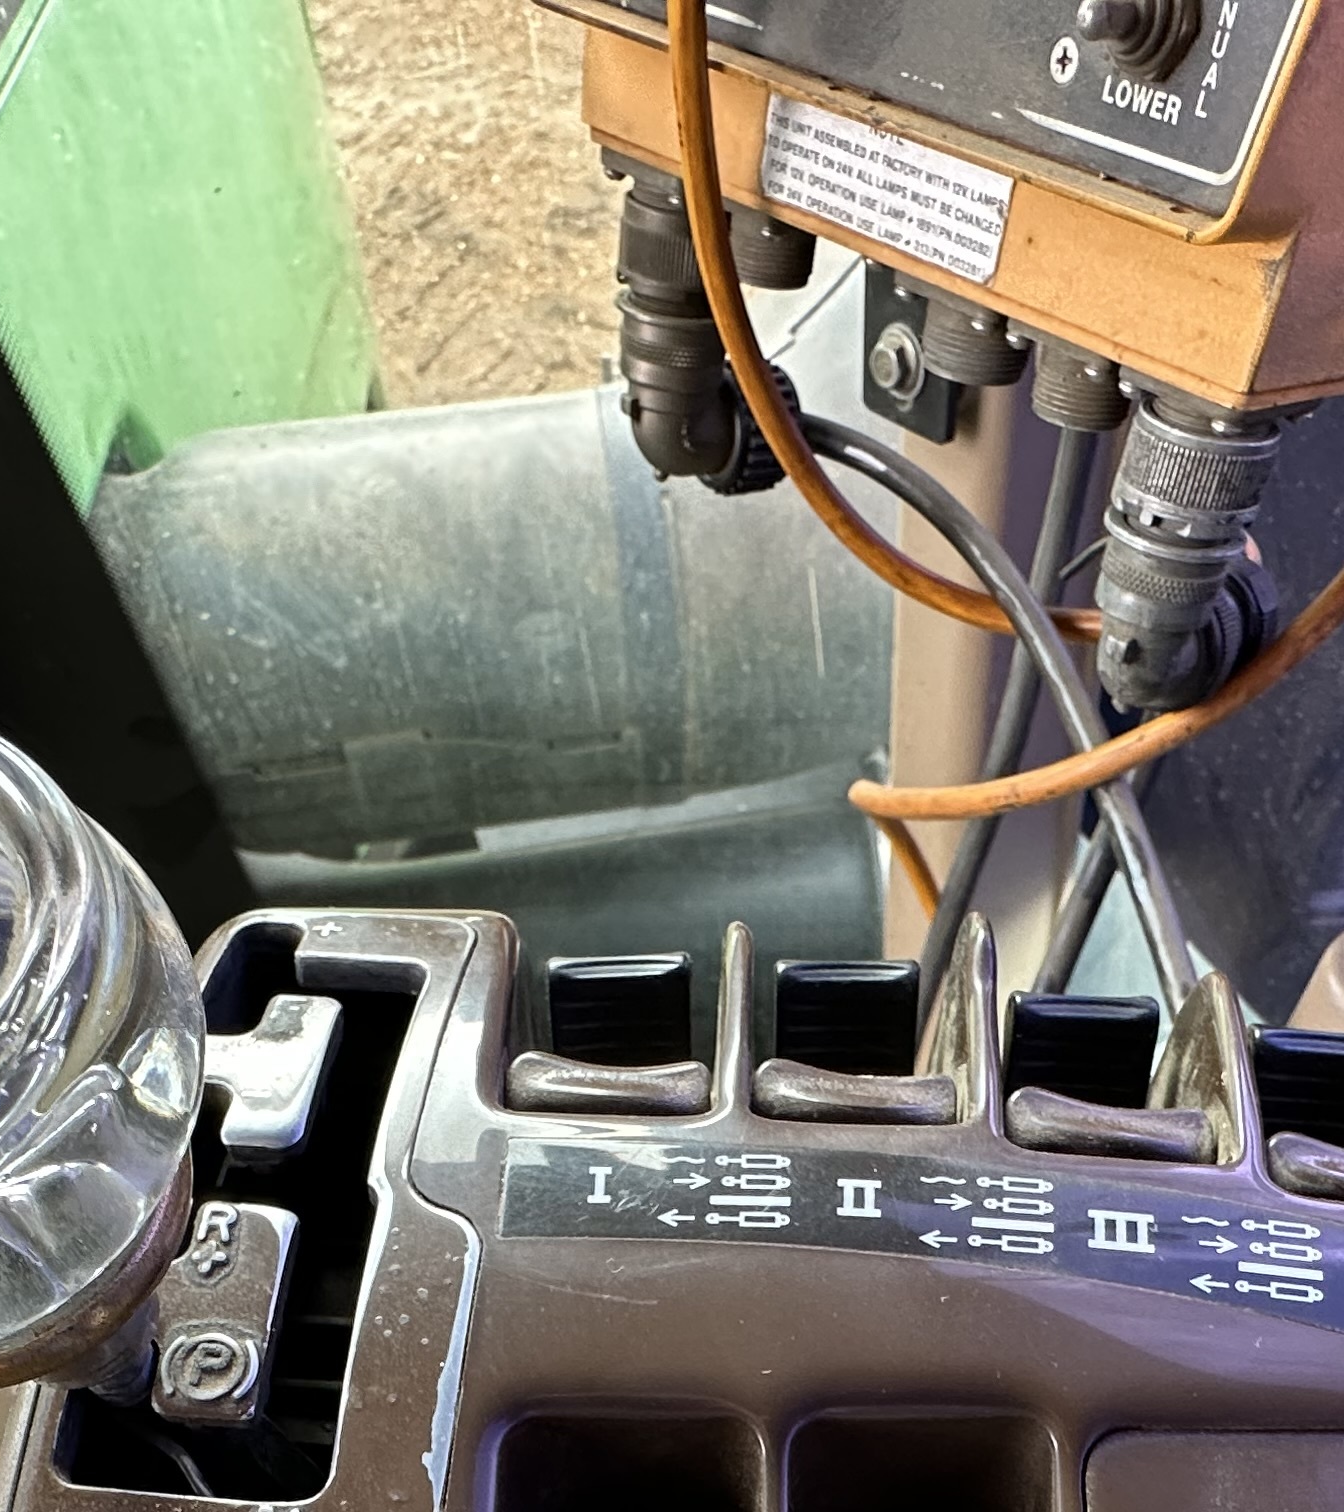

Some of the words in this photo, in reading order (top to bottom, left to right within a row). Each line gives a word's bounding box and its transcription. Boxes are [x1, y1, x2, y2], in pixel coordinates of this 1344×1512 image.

[1101, 75, 1182, 126] LOWER
[771, 112, 790, 130] THIS
[791, 120, 812, 136] UNIT
[814, 128, 867, 158] ASSEMBLED
[868, 150, 880, 163] AT
[882, 154, 923, 179] FACTORY
[925, 171, 950, 191] WITH
[768, 134, 780, 148] TO
[781, 140, 820, 165] OPERATE
[822, 155, 835, 169] ON
[857, 169, 873, 186] ALL
[876, 175, 908, 199] LAMPS
[910, 190, 937, 209] MUST
[940, 202, 953, 217] BE
[955, 208, 1002, 236] CHANGED
[768, 180, 784, 194] FOR
[807, 195, 853, 224] OPERATION
[771, 159, 787, 174] FOR
[808, 173, 856, 202] OPERATION
[881, 202, 906, 220] LAMP
[197, 1203, 238, 1242] R
